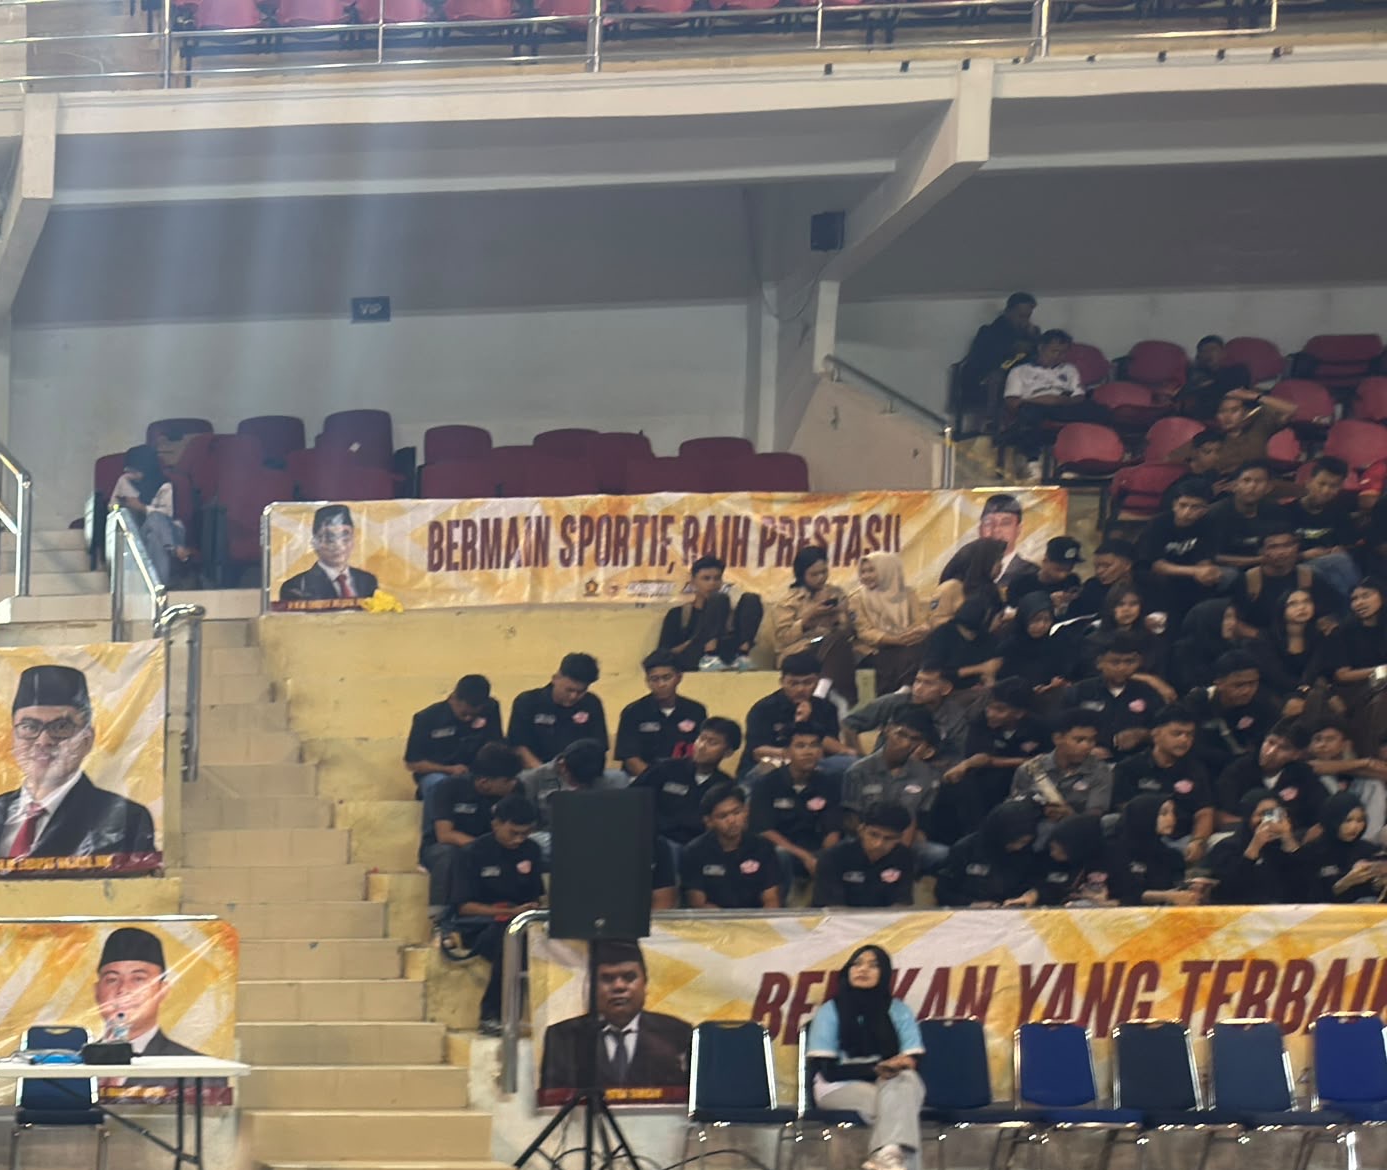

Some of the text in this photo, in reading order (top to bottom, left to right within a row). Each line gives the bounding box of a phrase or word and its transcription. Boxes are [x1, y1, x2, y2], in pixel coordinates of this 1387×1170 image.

[427, 514, 550, 573] BERMAIN
[559, 513, 677, 575] SPORTIF,
[683, 514, 748, 568] RAIH
[1020, 960, 1161, 1040] YANG
